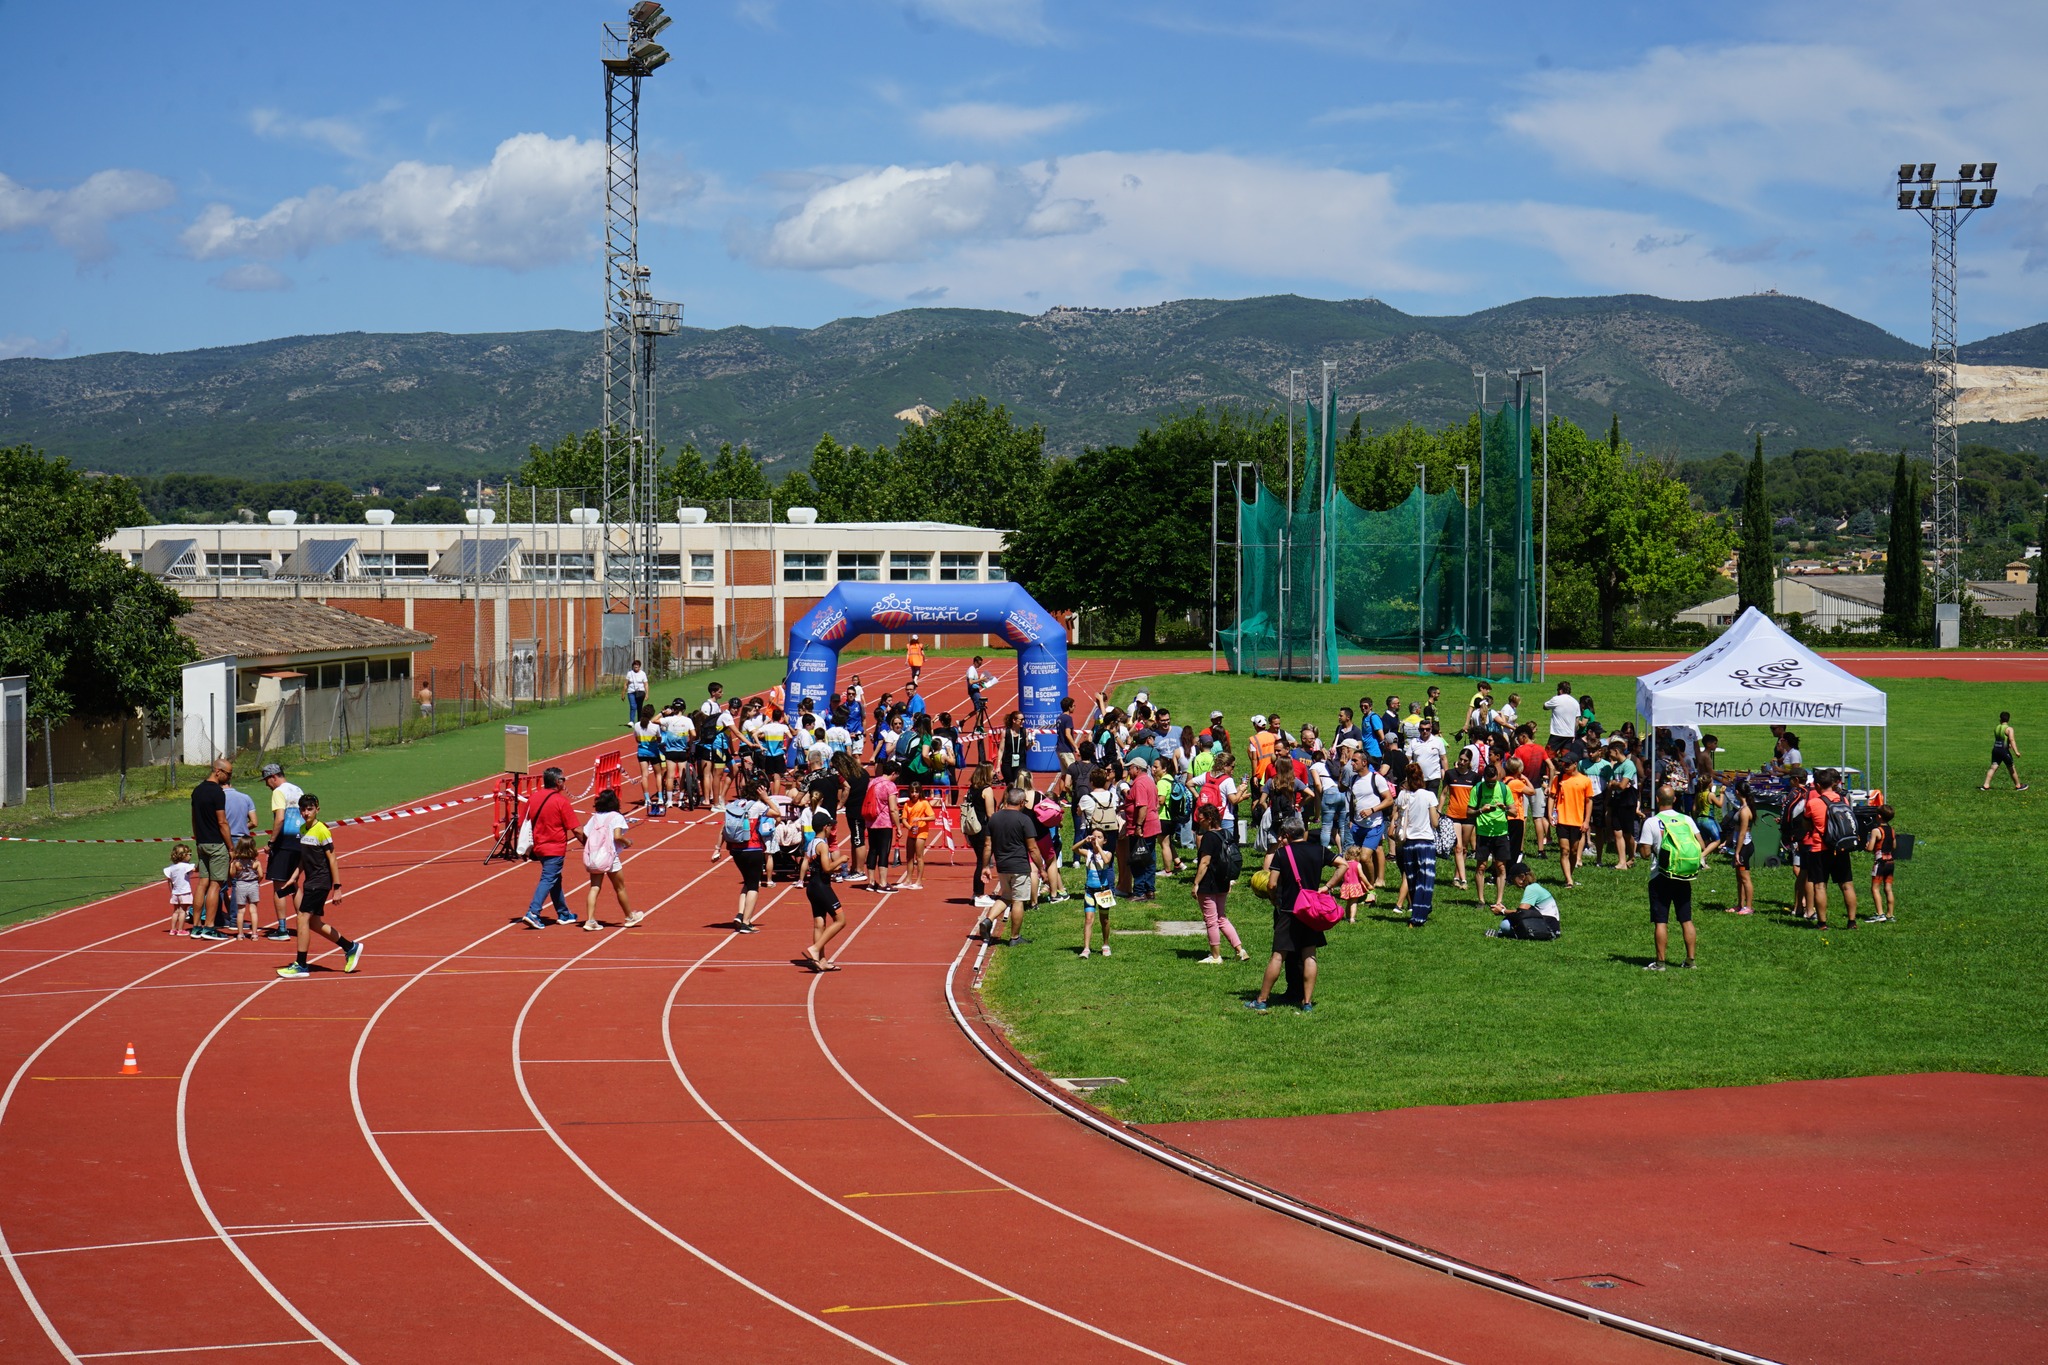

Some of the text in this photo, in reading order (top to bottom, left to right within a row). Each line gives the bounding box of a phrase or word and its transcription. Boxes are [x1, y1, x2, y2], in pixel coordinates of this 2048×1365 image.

[912, 609, 979, 622] TRIATLÓ
[1695, 698, 1843, 718] TRIATLÓ ONTINYENT
